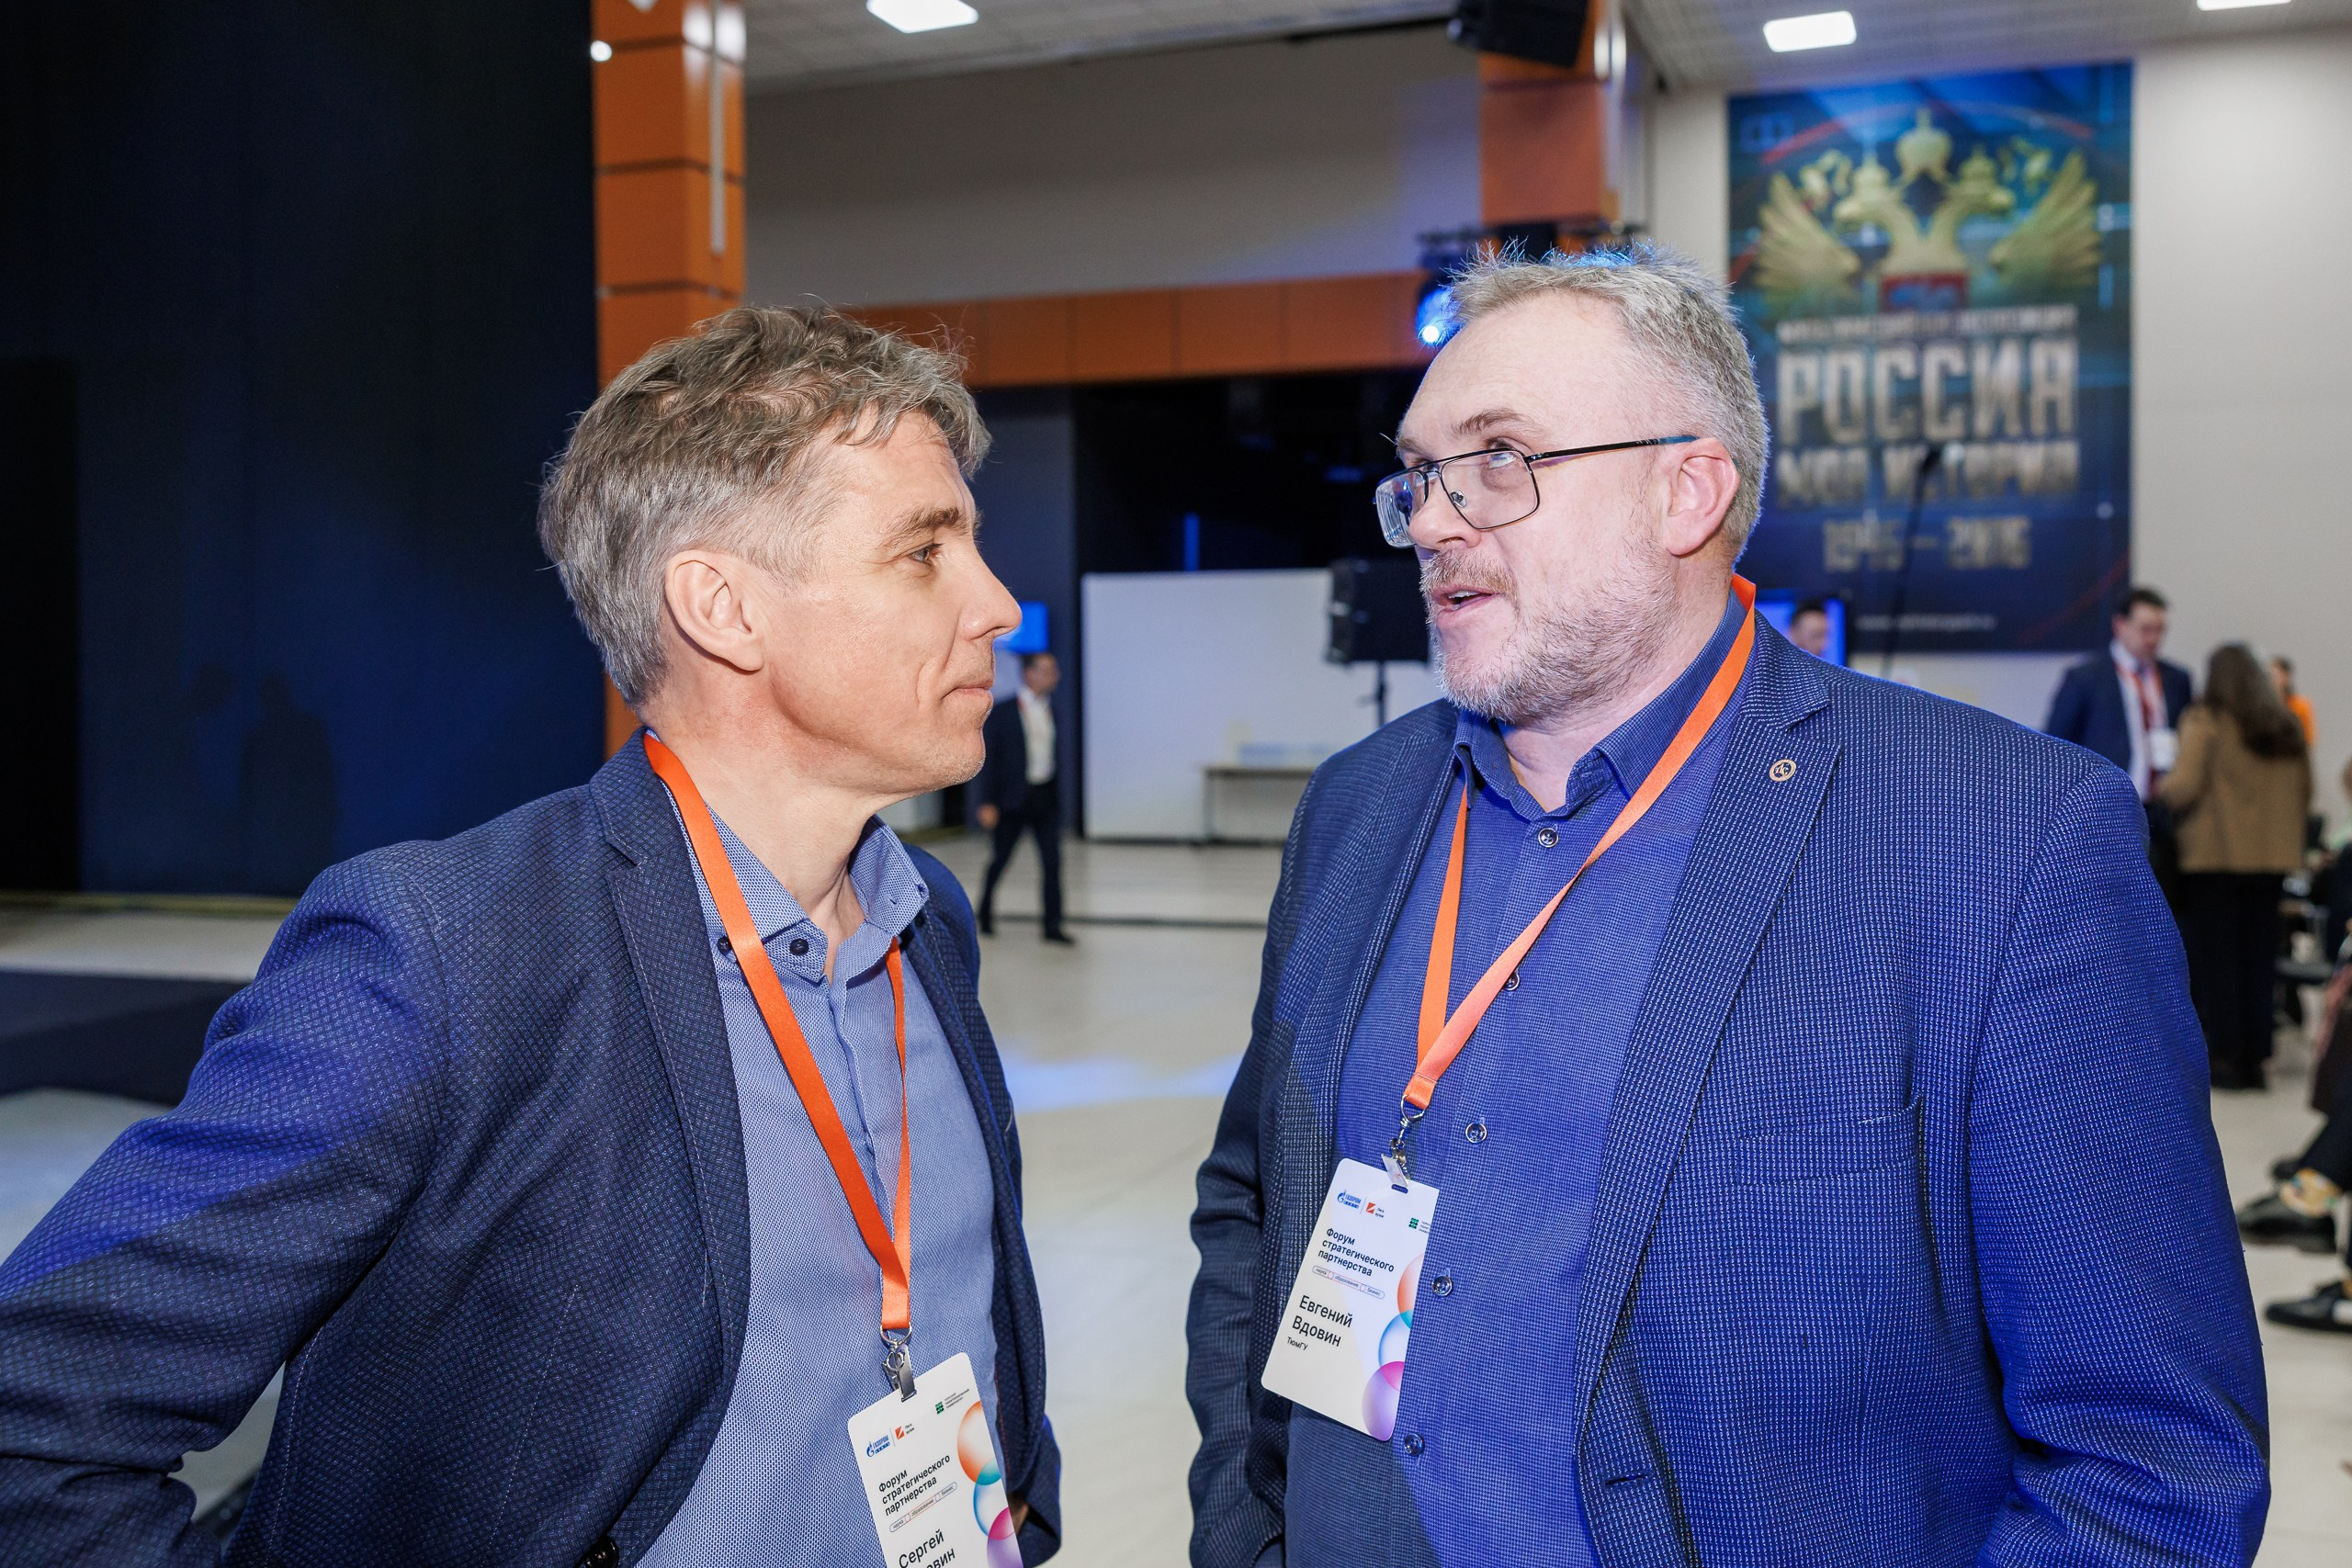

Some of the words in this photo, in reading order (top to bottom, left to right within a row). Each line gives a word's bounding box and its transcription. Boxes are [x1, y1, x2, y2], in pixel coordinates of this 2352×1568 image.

[1777, 337, 2078, 446] РОССИЯ
[1326, 1228, 1355, 1245] Форум
[1317, 1249, 1373, 1277] партнерства
[1322, 1239, 1395, 1272] стратегического
[1299, 1294, 1352, 1328] Евгений
[1287, 1337, 1308, 1350] ТюмГУ
[1292, 1315, 1341, 1347] Вдовин
[878, 1470, 908, 1493] Форум
[882, 1455, 950, 1505] стратегического
[885, 1476, 937, 1516] партнерства
[899, 1529, 944, 1568] Сергей
